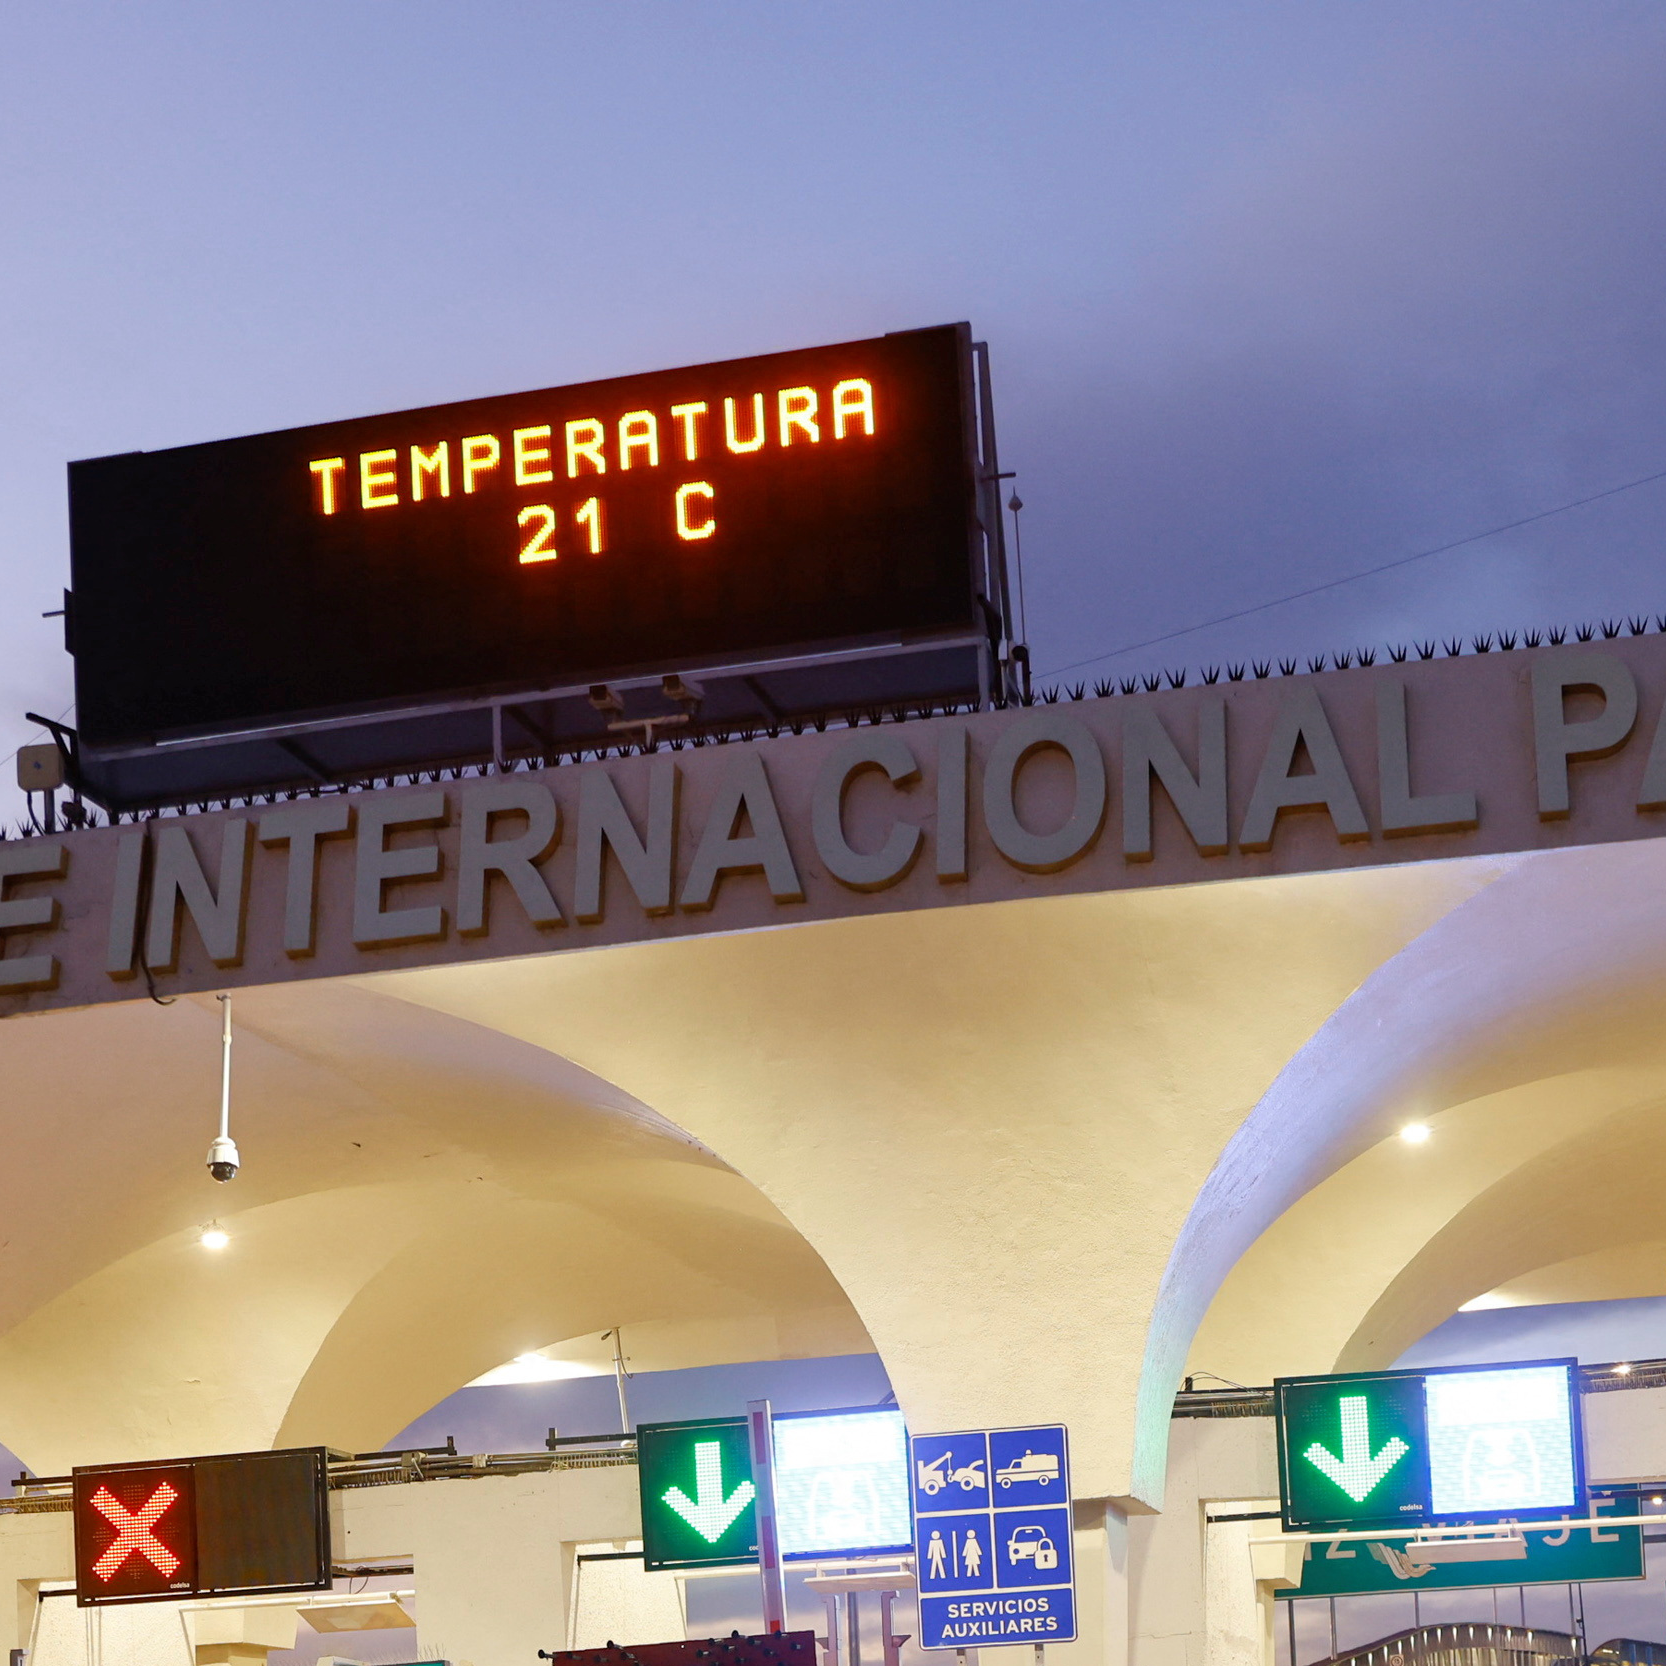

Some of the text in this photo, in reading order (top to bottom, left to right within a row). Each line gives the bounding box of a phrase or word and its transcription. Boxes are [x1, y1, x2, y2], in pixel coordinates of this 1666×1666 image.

[308, 377, 878, 516] TEMPERATURA
[517, 479, 718, 565] 21 C
[105, 681, 1478, 981] INTERNACIONAL
[941, 1616, 1058, 1638] AUXILIARES
[947, 1597, 1049, 1618] SERVICIOS
